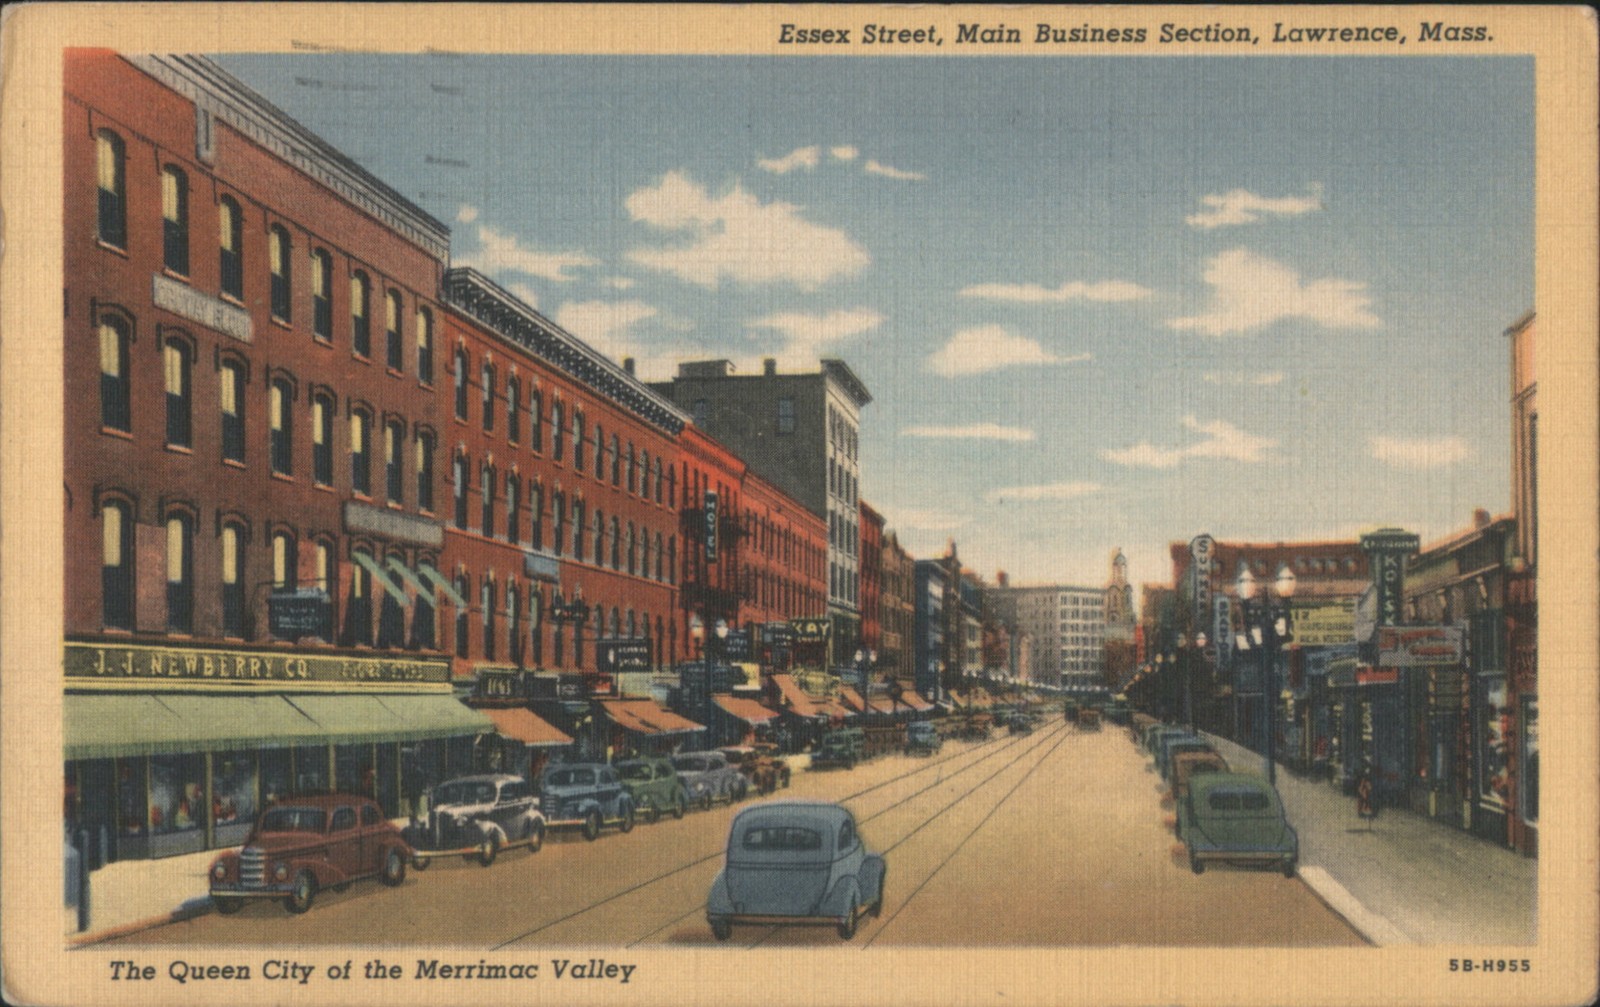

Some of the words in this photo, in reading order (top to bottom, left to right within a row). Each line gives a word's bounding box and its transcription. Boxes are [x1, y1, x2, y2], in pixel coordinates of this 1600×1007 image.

[706, 502, 715, 558] HOTEL
[793, 622, 830, 636] KAY
[94, 650, 113, 675] J.
[122, 651, 141, 675] J.
[150, 652, 274, 678] NEWBERRY
